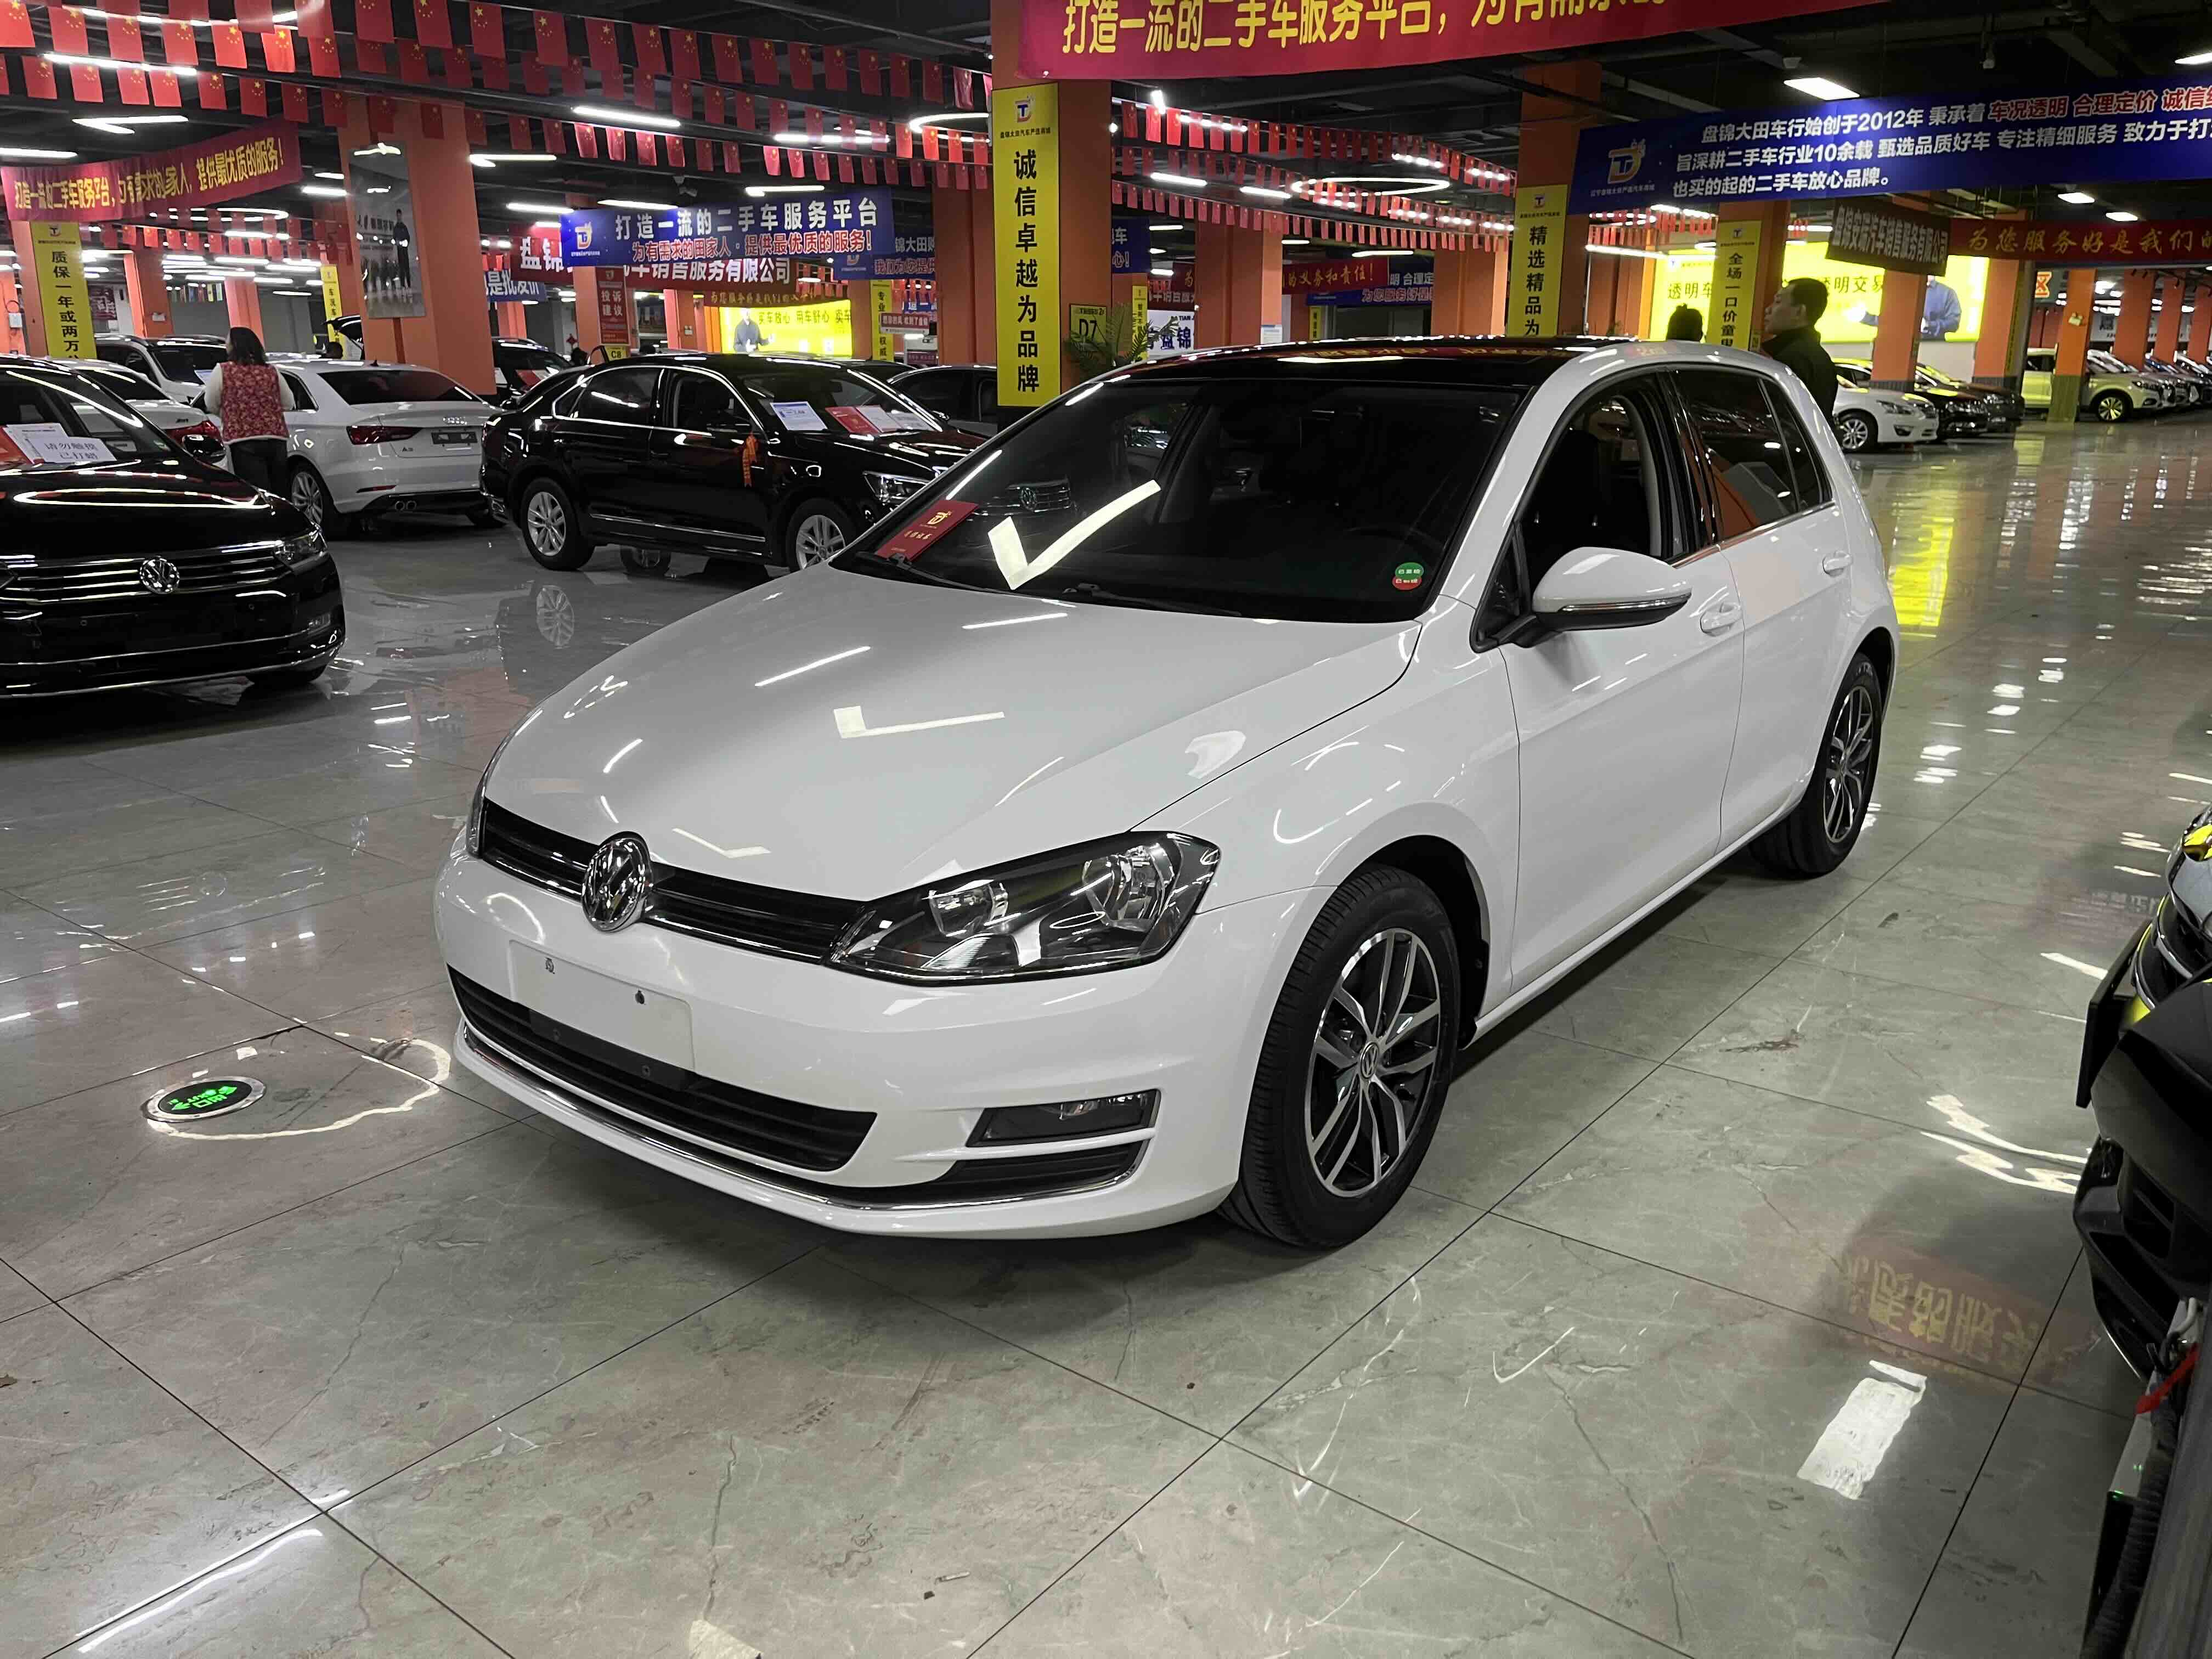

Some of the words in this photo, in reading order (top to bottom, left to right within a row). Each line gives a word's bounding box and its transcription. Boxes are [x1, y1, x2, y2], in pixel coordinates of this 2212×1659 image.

[1701, 108, 1923, 144] 盘锦大田车行始创于2012年
[1929, 103, 1985, 126] 秉承着
[1988, 96, 2068, 122] 车况透明
[2073, 91, 2157, 117] 合理定价
[1877, 131, 1991, 159] 甄选品质好车
[1997, 123, 2117, 149] 专注精细服务
[2123, 119, 2212, 143] 致力于打
[616, 198, 877, 240] 打造一流的二手车服务平台
[1014, 149, 1039, 392] 诚信卓越为品牌
[1525, 226, 1548, 336] 精选精品为
[1821, 275, 1884, 294] 明交易
